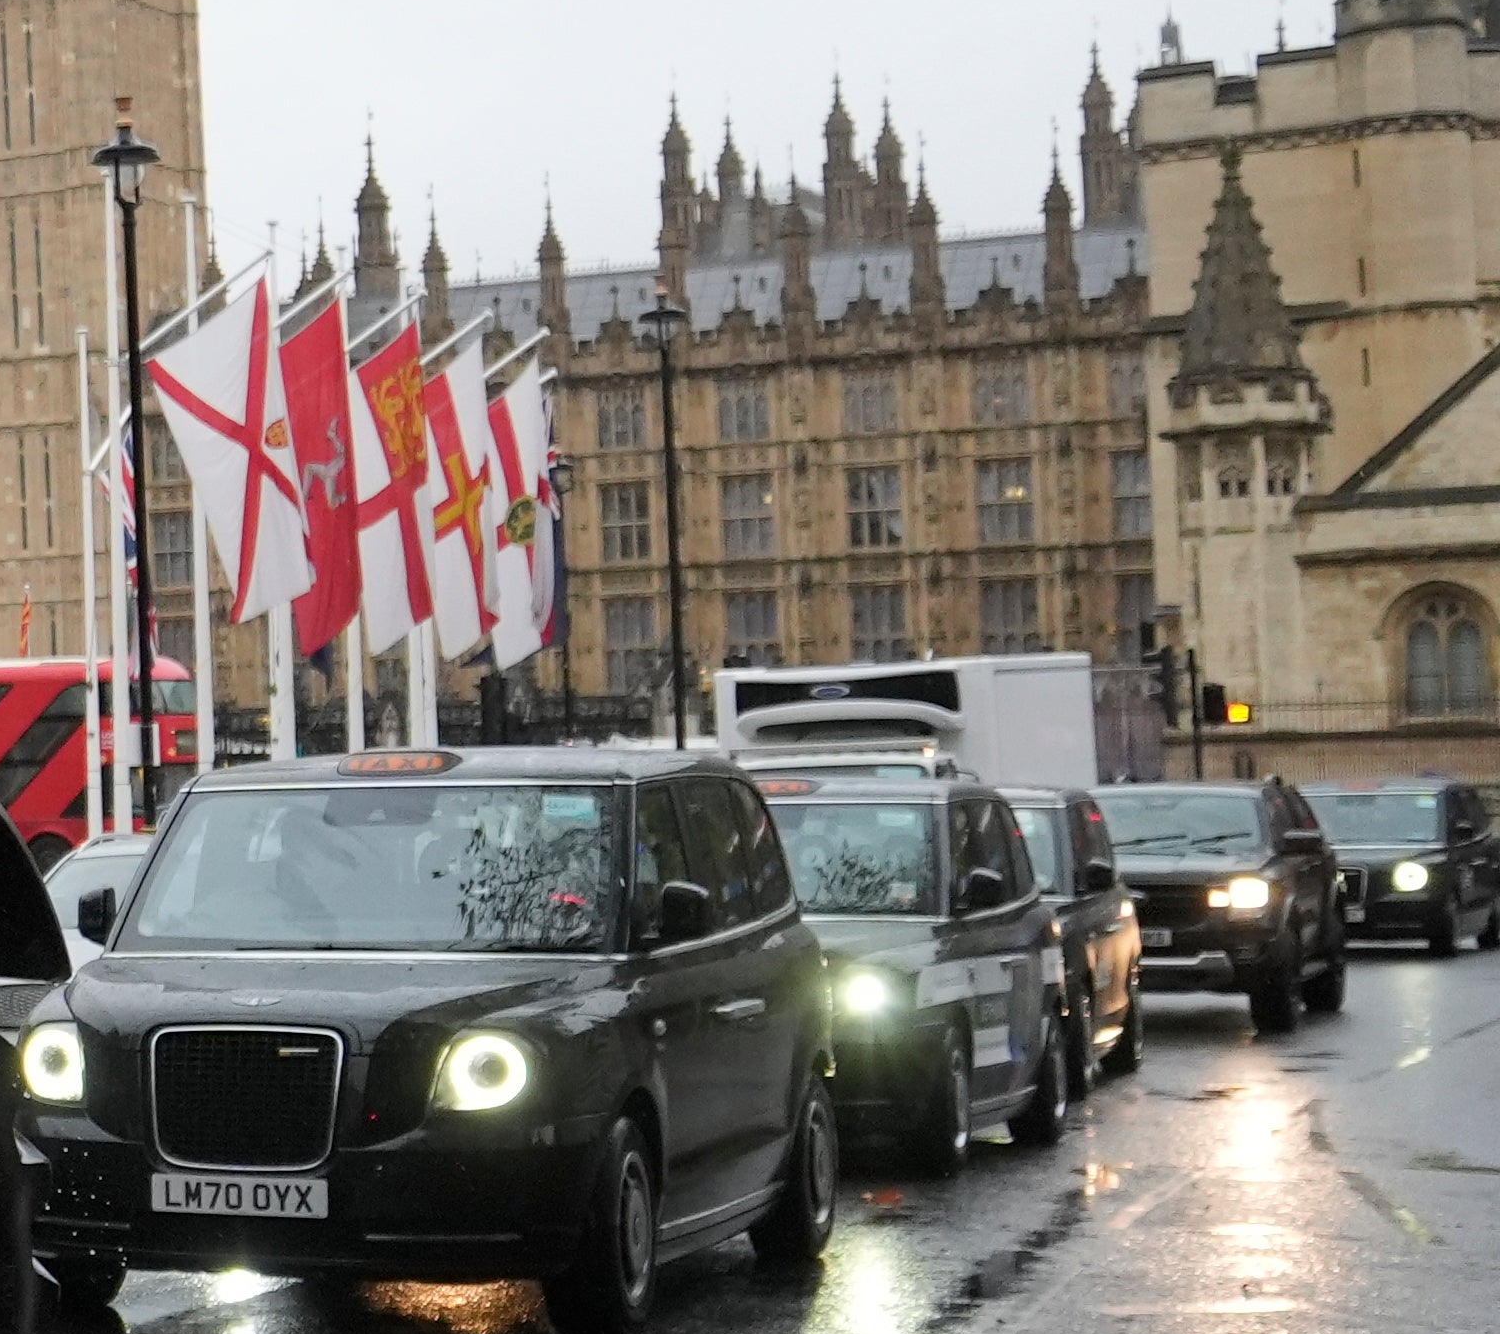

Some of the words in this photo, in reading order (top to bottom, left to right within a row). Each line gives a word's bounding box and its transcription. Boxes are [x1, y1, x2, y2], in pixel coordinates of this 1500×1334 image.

[351, 756, 439, 771] TAXI
[165, 1180, 243, 1210] LM70
[252, 1183, 313, 1214] OYX
